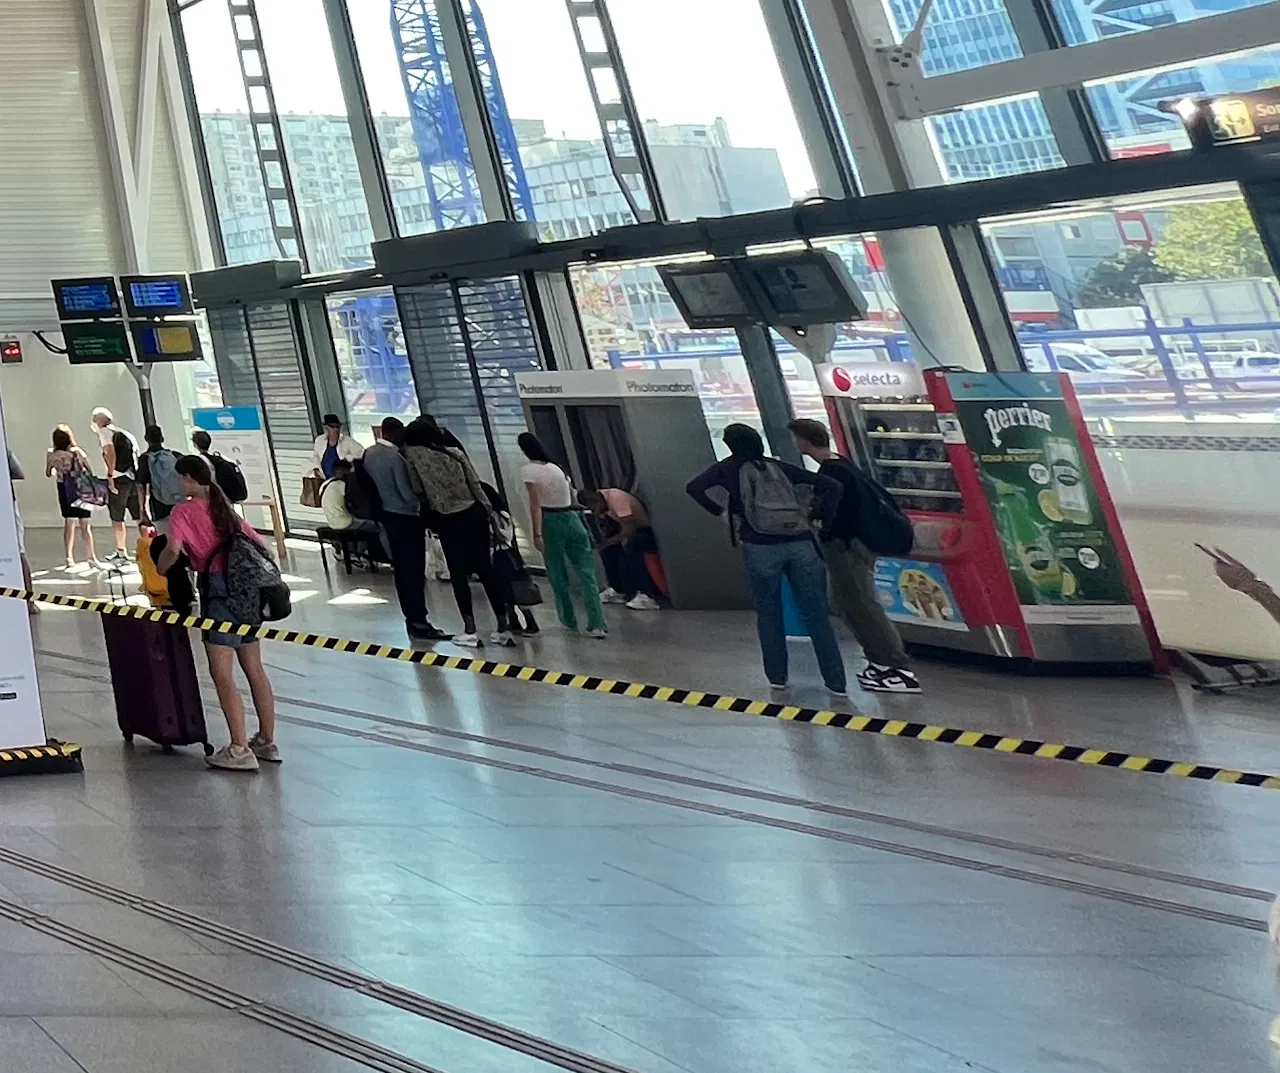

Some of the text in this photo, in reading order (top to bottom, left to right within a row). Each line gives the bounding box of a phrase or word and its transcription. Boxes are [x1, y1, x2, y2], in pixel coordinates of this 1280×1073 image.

[625, 381, 694, 393] Photomaton
[853, 373, 901, 387] selecta
[984, 402, 1052, 448] perrier
